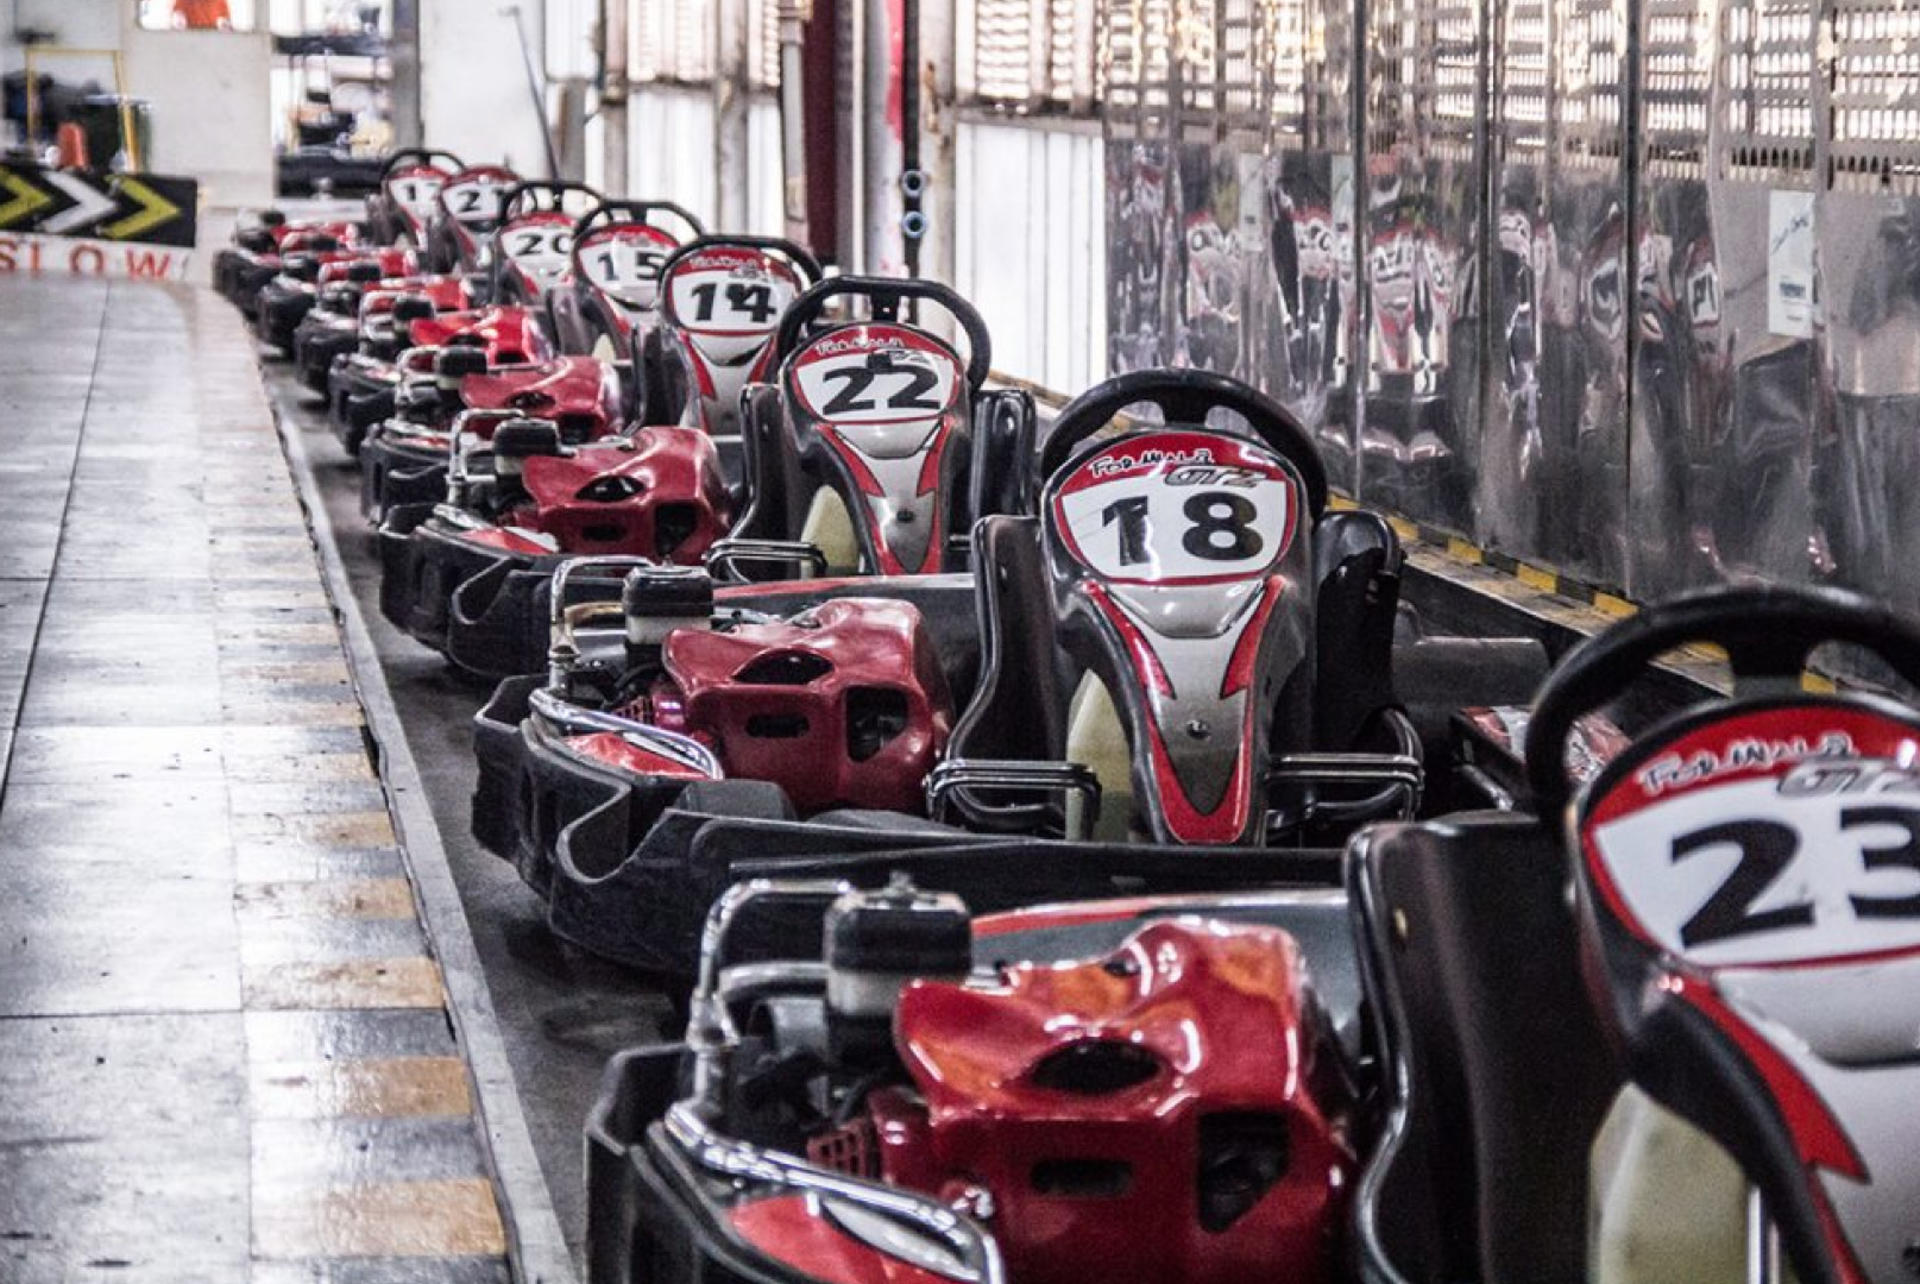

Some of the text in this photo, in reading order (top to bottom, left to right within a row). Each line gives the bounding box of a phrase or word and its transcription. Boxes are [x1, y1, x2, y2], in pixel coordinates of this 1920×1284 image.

[597, 251, 668, 281] 15
[691, 282, 777, 323] 14
[822, 364, 942, 415] 22
[1101, 491, 1264, 566] 18
[1671, 805, 1920, 948] 23
